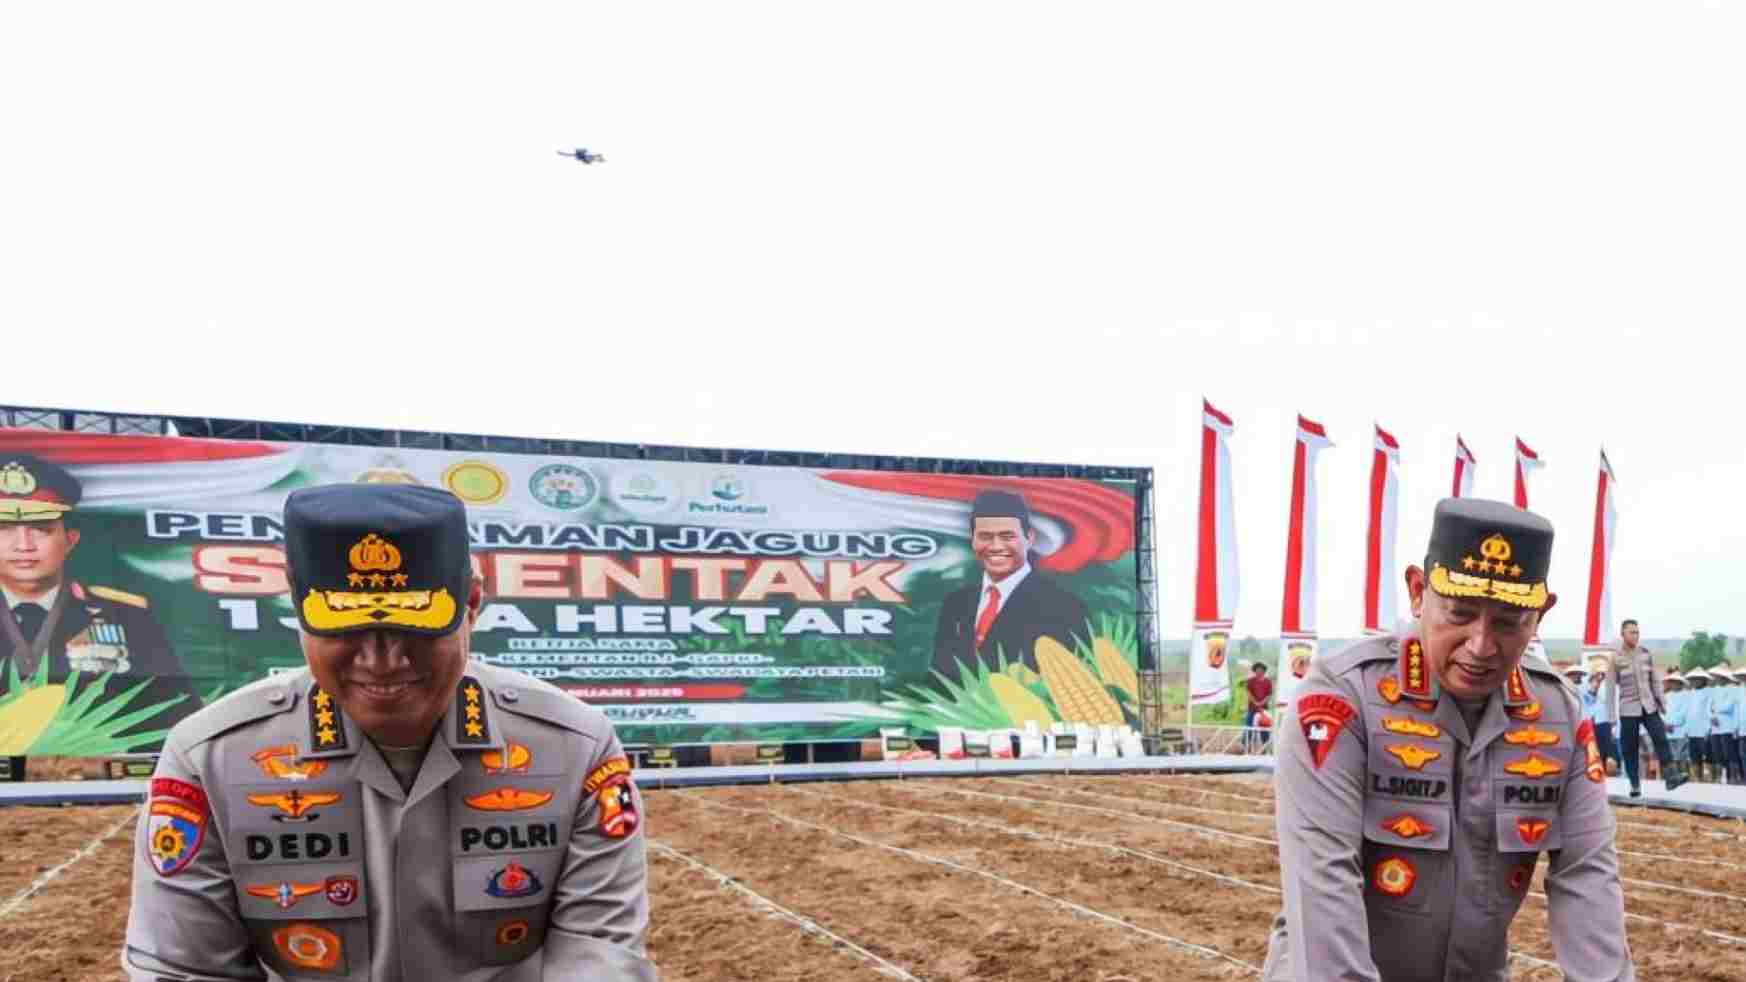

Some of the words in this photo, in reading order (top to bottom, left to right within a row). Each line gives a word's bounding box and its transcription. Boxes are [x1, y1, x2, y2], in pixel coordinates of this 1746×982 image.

[660, 527, 938, 558] JAGUNG
[554, 605, 893, 635] HEKTAR
[246, 832, 349, 861] DEDI
[461, 824, 558, 851] POLRI
